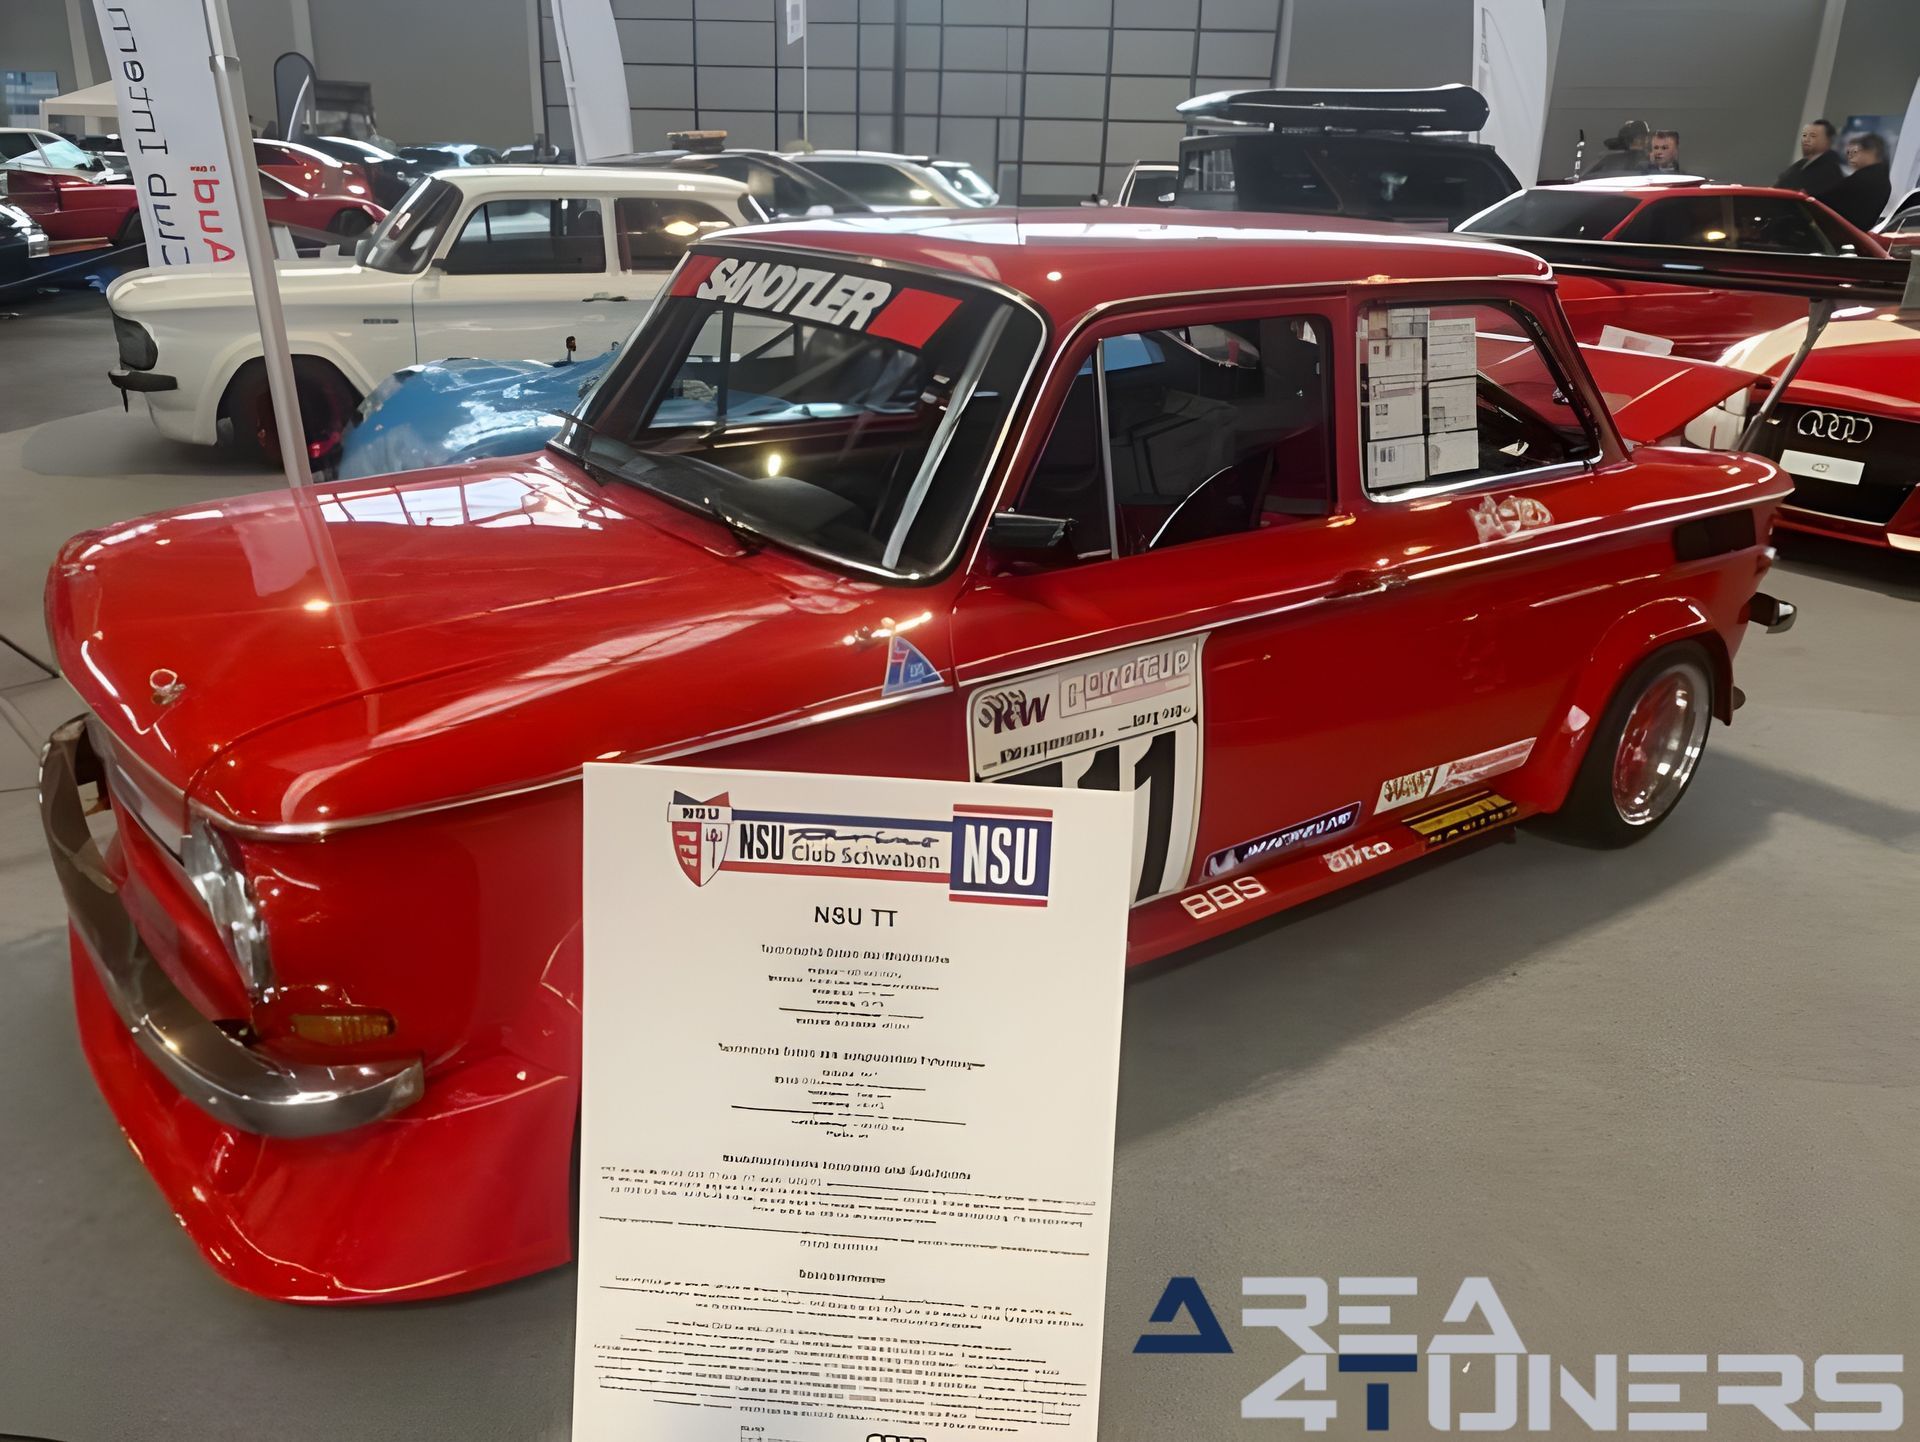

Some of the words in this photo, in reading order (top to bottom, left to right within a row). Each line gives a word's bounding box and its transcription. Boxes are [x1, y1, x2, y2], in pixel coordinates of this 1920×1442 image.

[696, 258, 892, 331] SANDTLER
[739, 823, 785, 860] NSU
[791, 843, 836, 863] Club
[962, 823, 1039, 887] NSU
[814, 905, 862, 926] NSU
[1180, 876, 1267, 919] BBS
